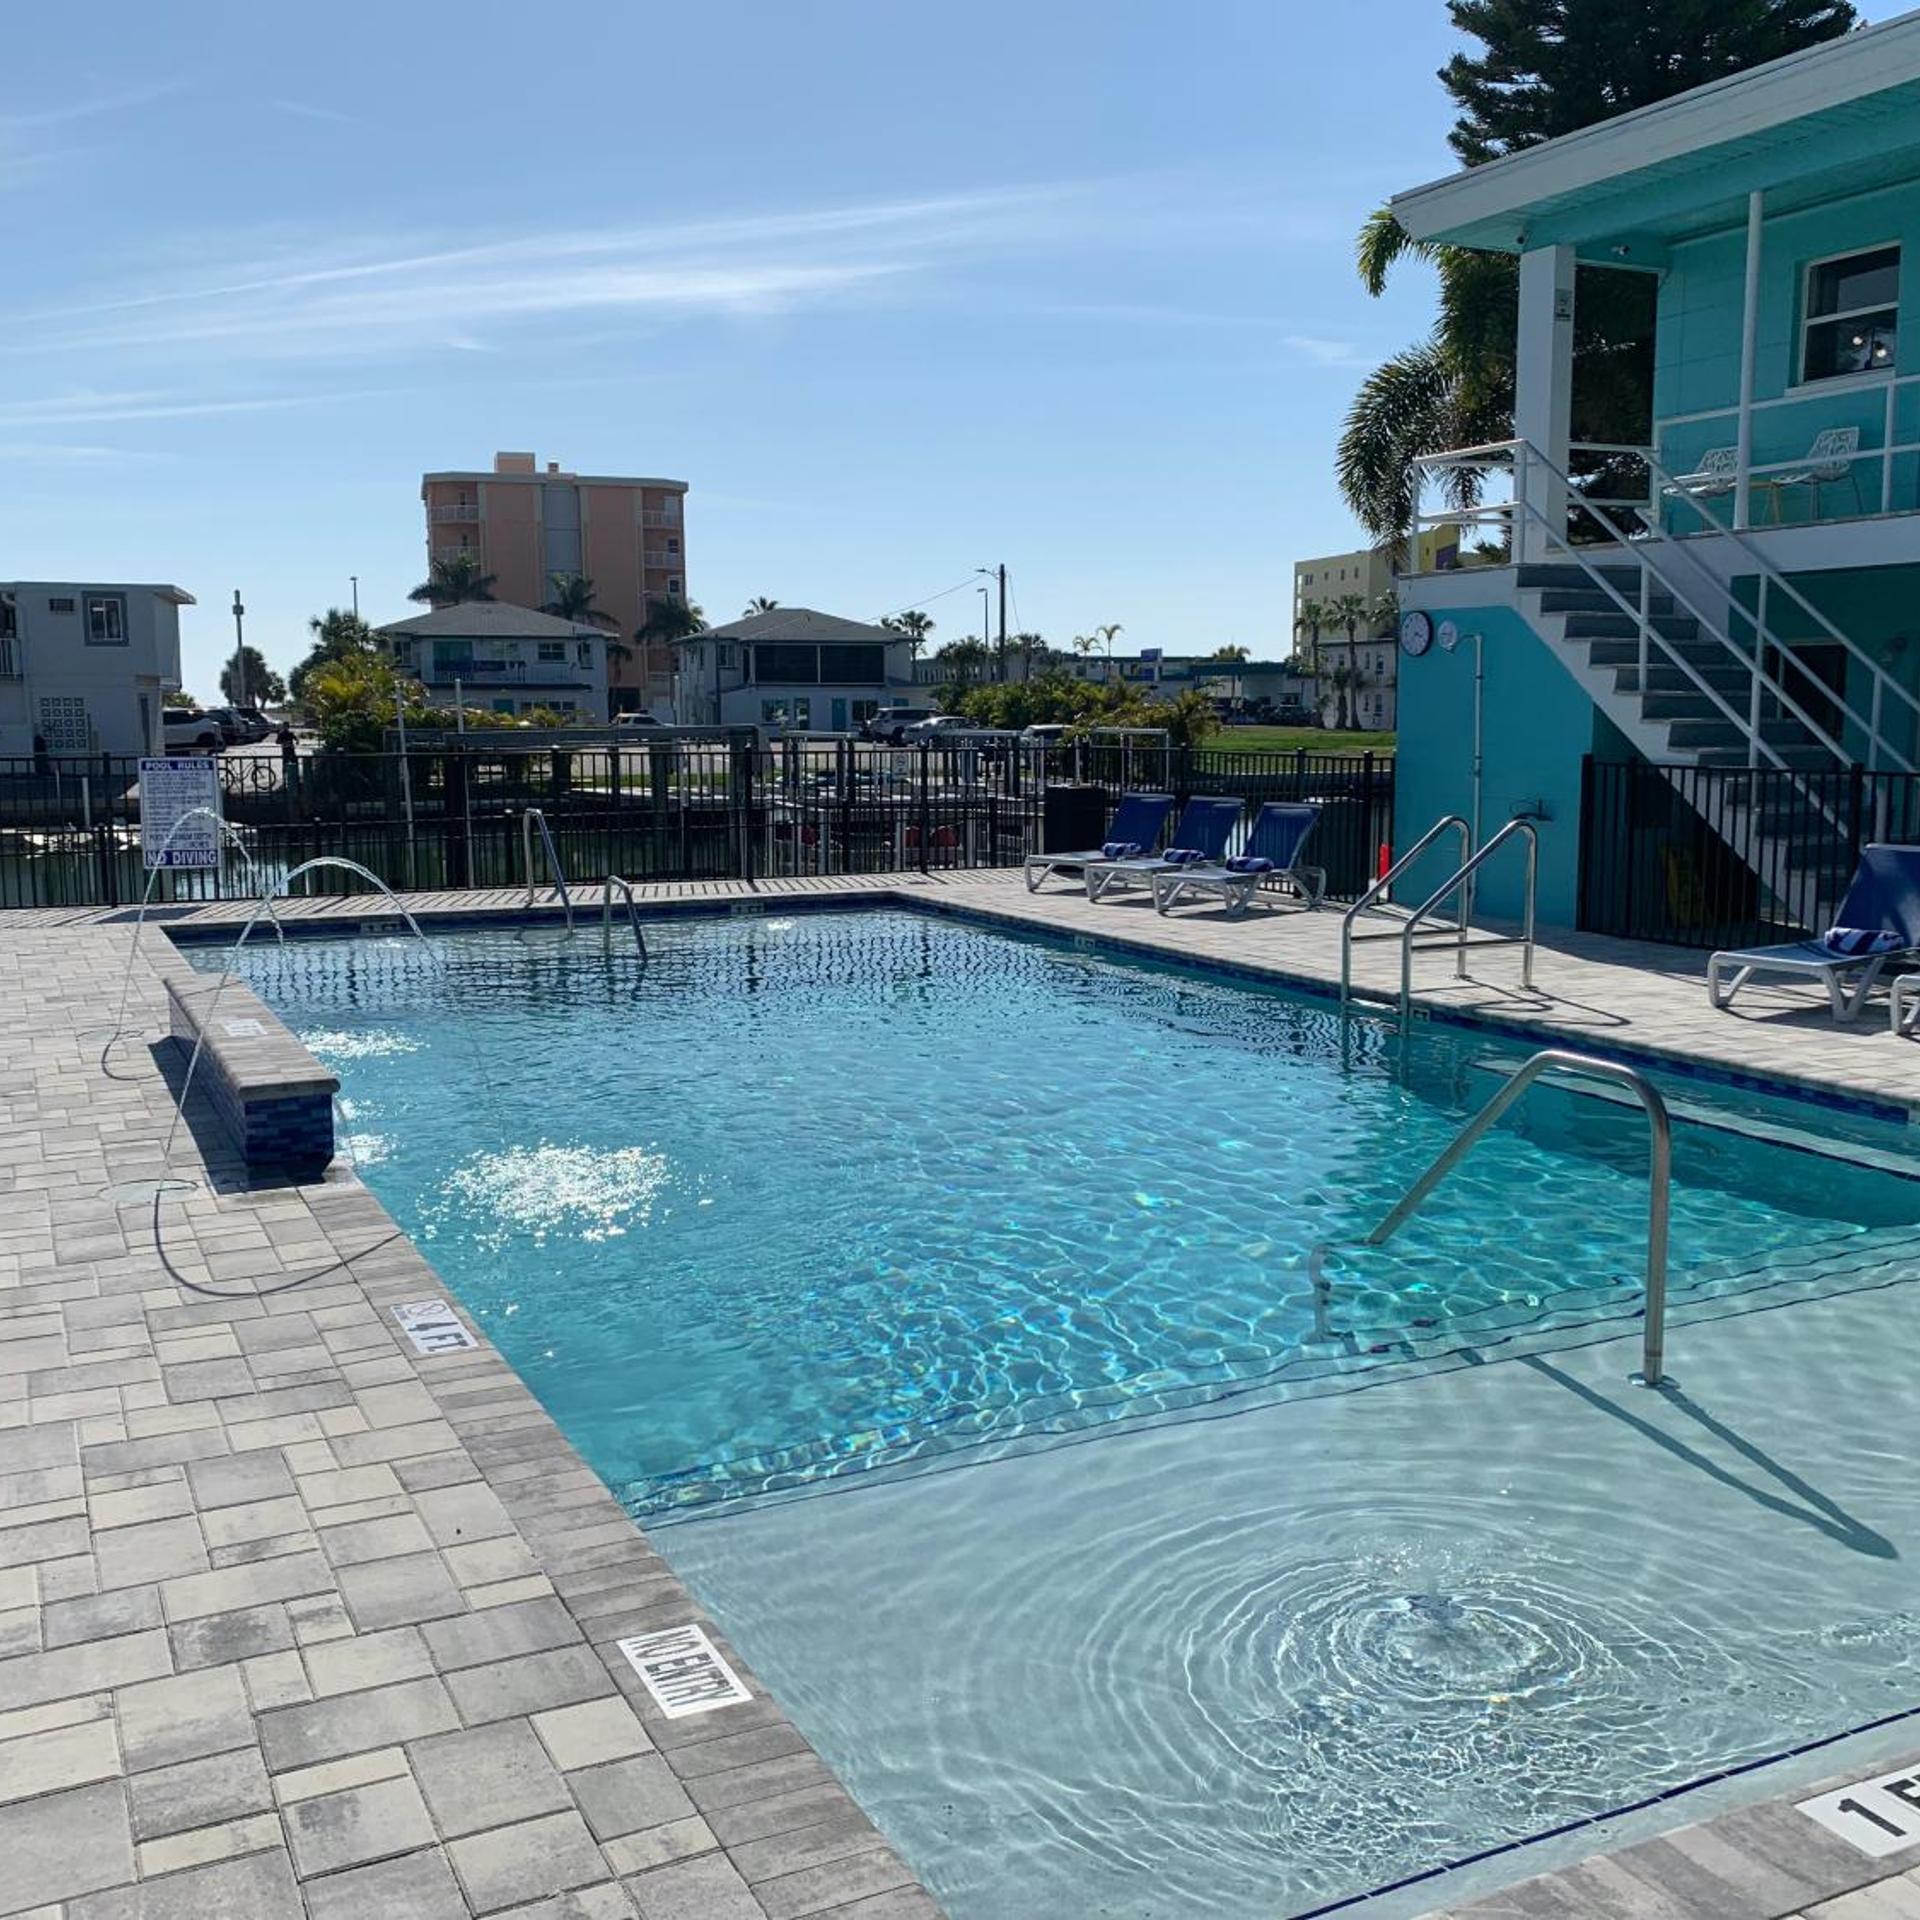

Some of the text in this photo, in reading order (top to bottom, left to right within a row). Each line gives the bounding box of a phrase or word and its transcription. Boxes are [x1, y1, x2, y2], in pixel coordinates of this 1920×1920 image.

[145, 760, 210, 769] POOL RULES
[147, 850, 217, 866] NO DIVING
[420, 1332, 469, 1352] FT
[627, 1629, 740, 1708] NO ENTRY
[1837, 1774, 1920, 1837] 1 F
